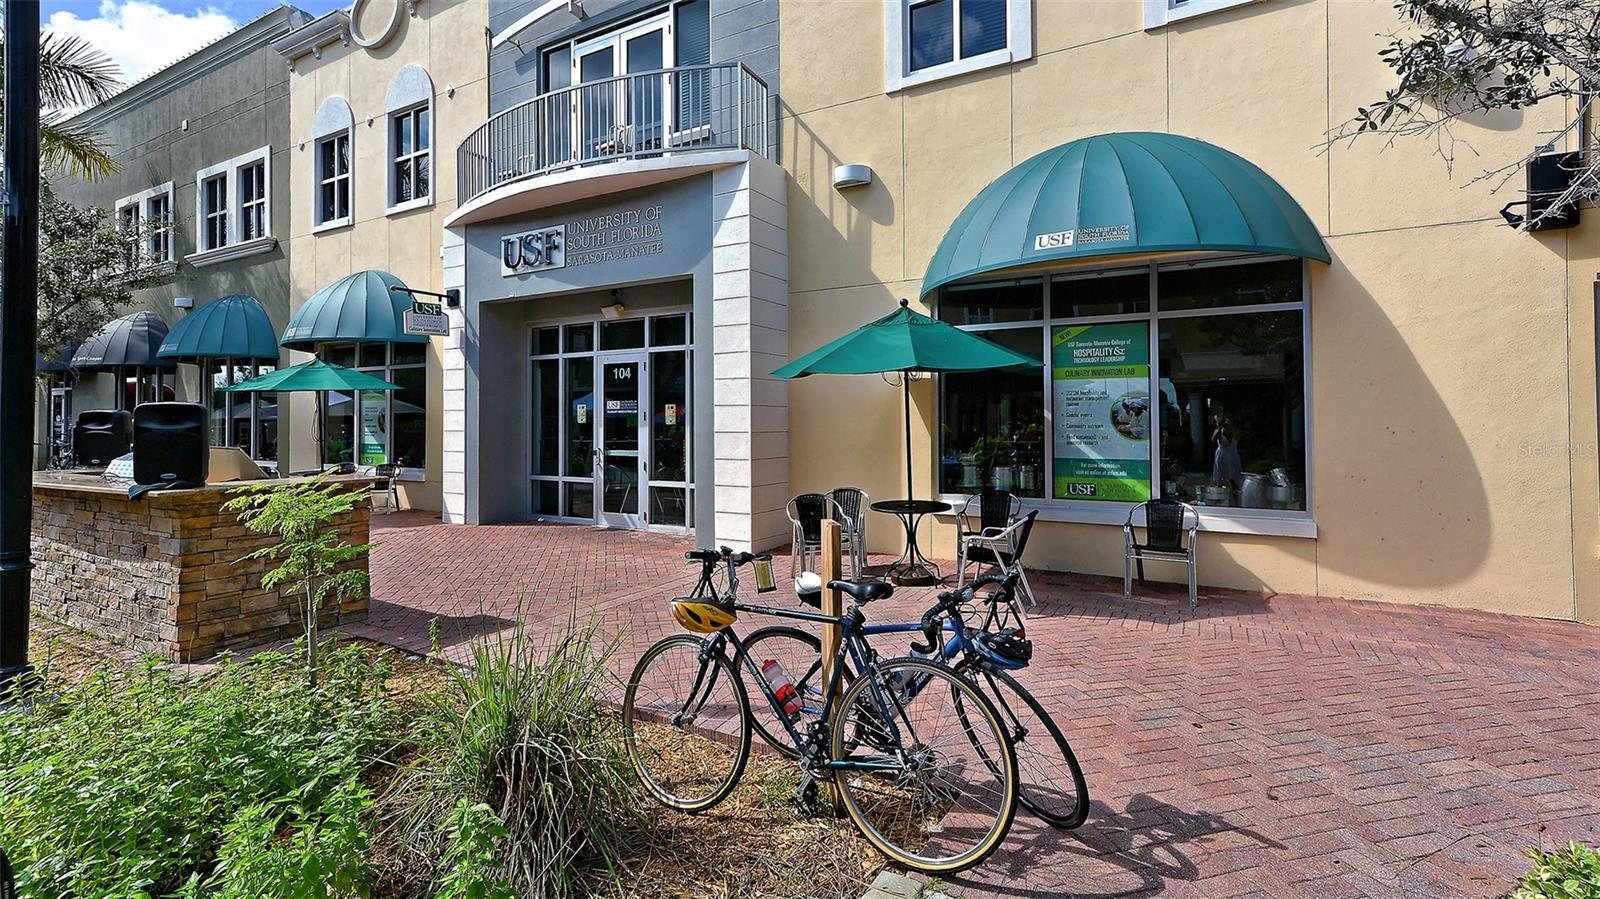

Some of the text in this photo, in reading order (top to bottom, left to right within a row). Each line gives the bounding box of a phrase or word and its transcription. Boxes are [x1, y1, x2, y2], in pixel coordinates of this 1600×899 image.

[567, 206, 662, 235] UNIVERSITY OF
[567, 224, 662, 250] SOUTH FLORIDA
[1039, 232, 1072, 248] USF
[501, 230, 561, 268] USF
[567, 242, 663, 266] SARASOTA-MANATEE
[415, 303, 440, 314] USF
[1074, 346, 1125, 357] HOSPITALITY &
[613, 368, 631, 379] 104
[1091, 368, 1123, 376] INNOVATION
[1069, 484, 1095, 495] USF
